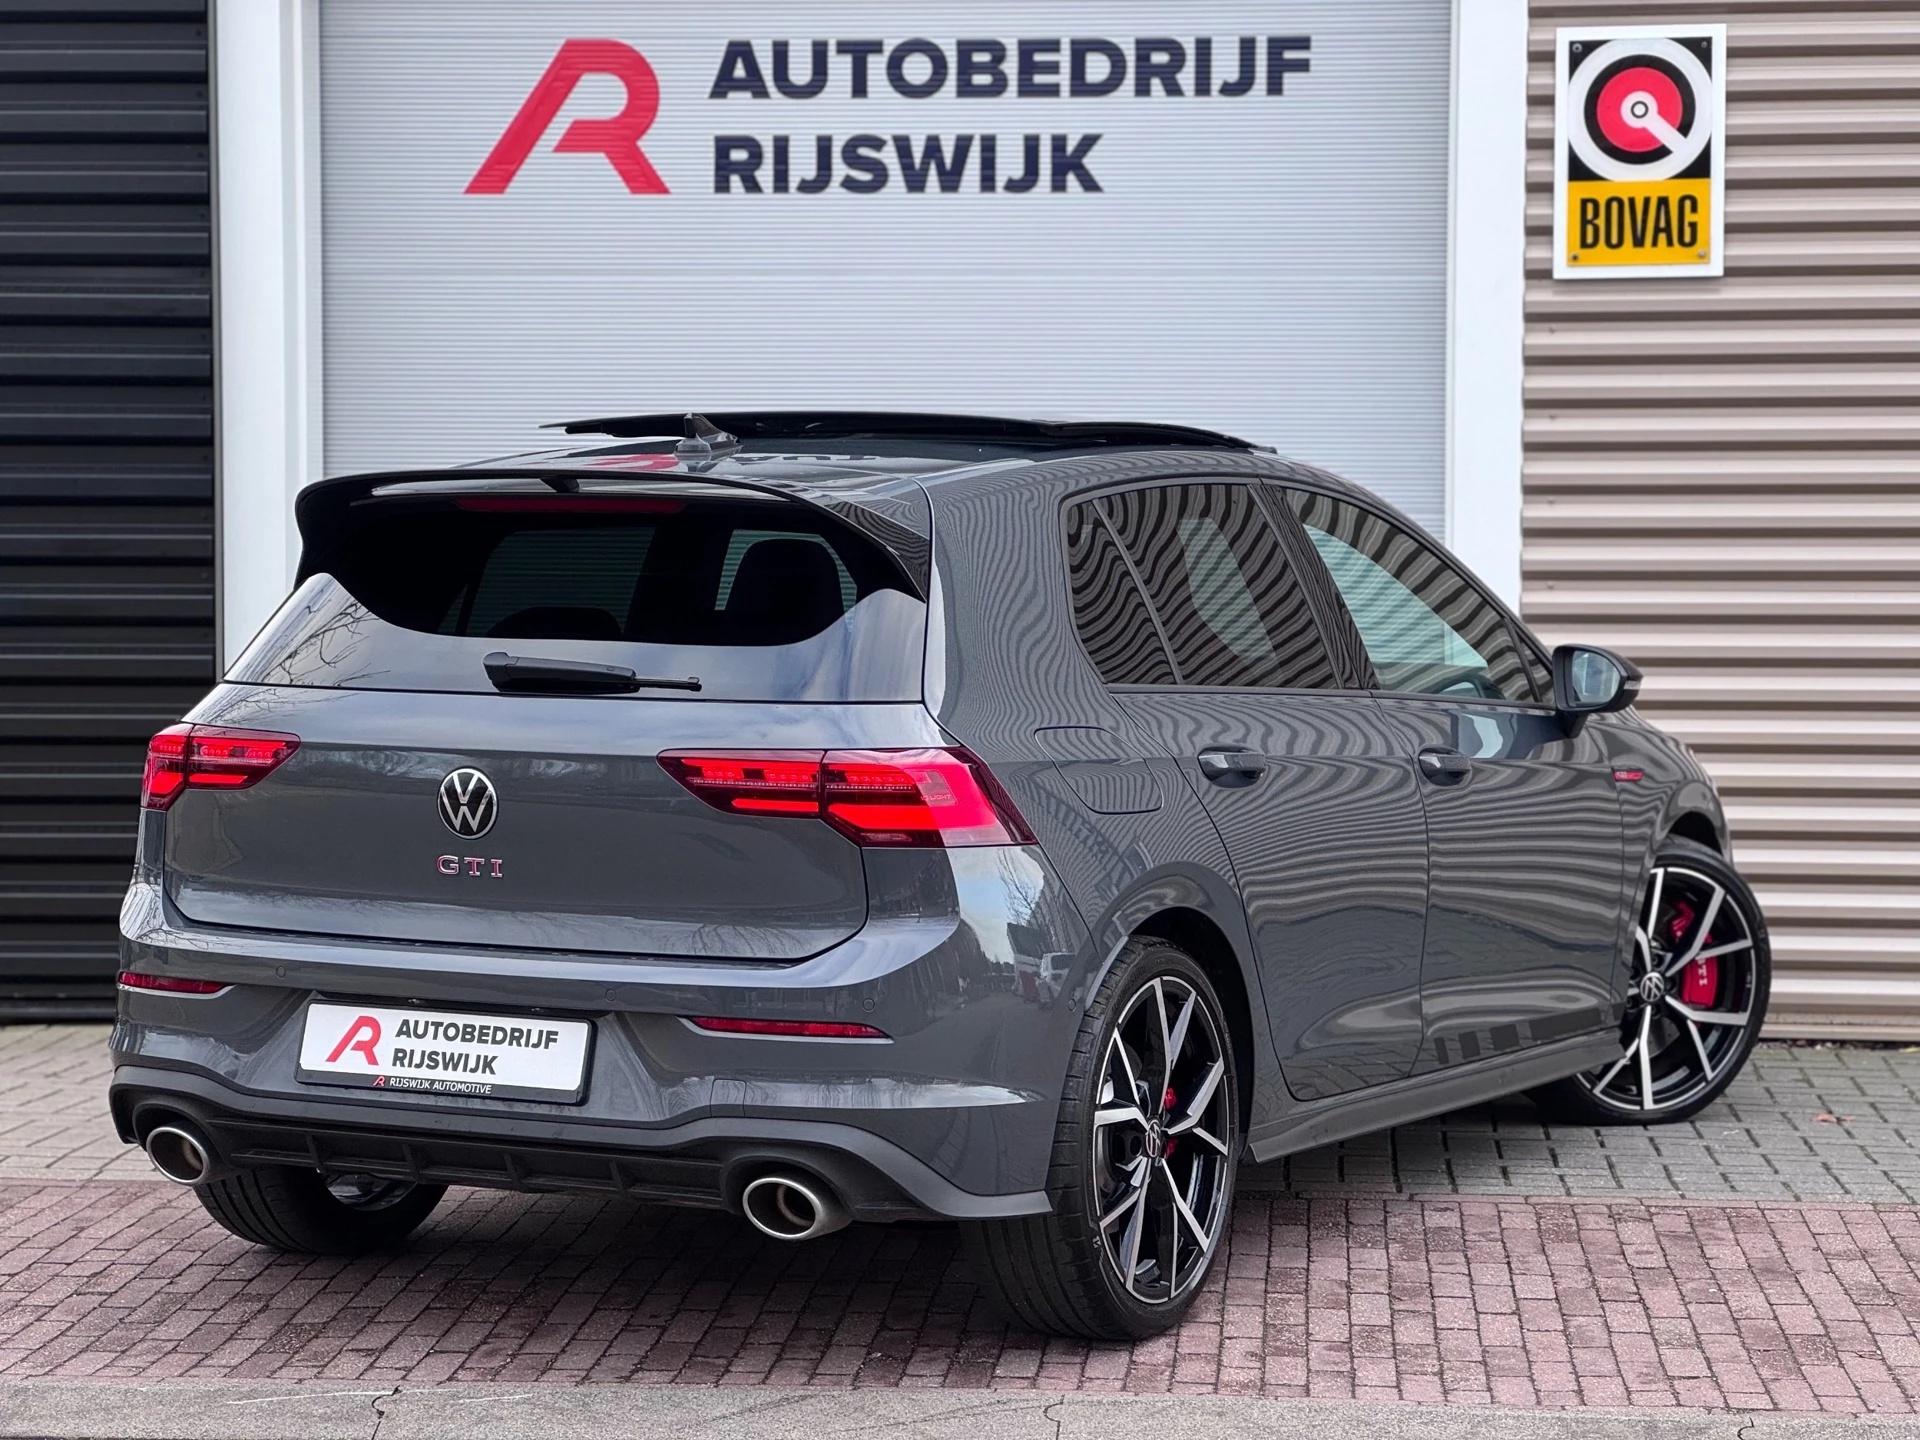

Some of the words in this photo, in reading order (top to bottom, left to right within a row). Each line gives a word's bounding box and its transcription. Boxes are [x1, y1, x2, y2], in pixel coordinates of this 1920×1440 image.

[709, 35, 1312, 100] AUTOBEDRIJF
[714, 133, 1103, 195] RIJSWIJK
[1579, 194, 1698, 250] BOVAG
[436, 854, 503, 878] GTI
[395, 1019, 559, 1050] AUTOBEDRIJF
[391, 1048, 499, 1075] RIJSWIJK
[389, 1077, 431, 1089] RIJSWIJK
[432, 1081, 492, 1094] AUTOMOTIVE
